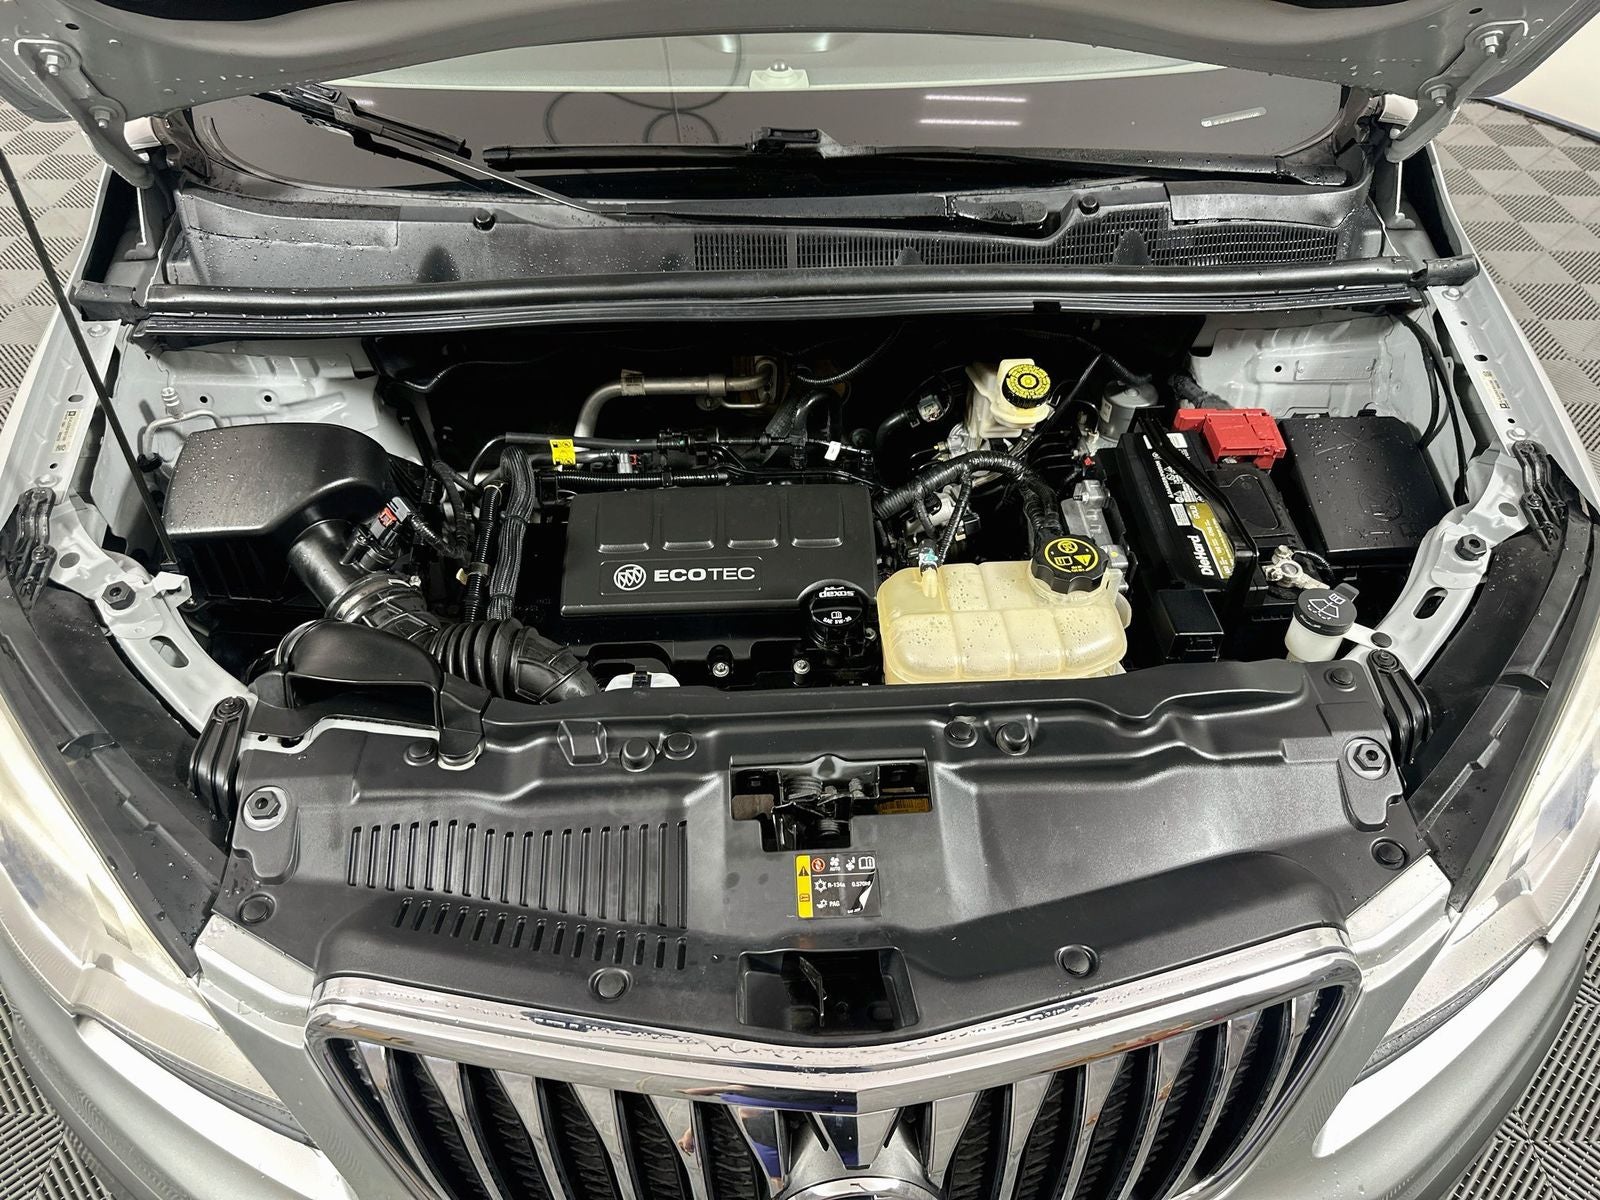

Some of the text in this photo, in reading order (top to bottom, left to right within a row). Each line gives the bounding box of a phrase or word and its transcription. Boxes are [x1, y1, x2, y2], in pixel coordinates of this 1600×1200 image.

[1189, 505, 1200, 519] GOLD
[1187, 535, 1215, 576] DieHard
[653, 567, 755, 582] ECOTEC
